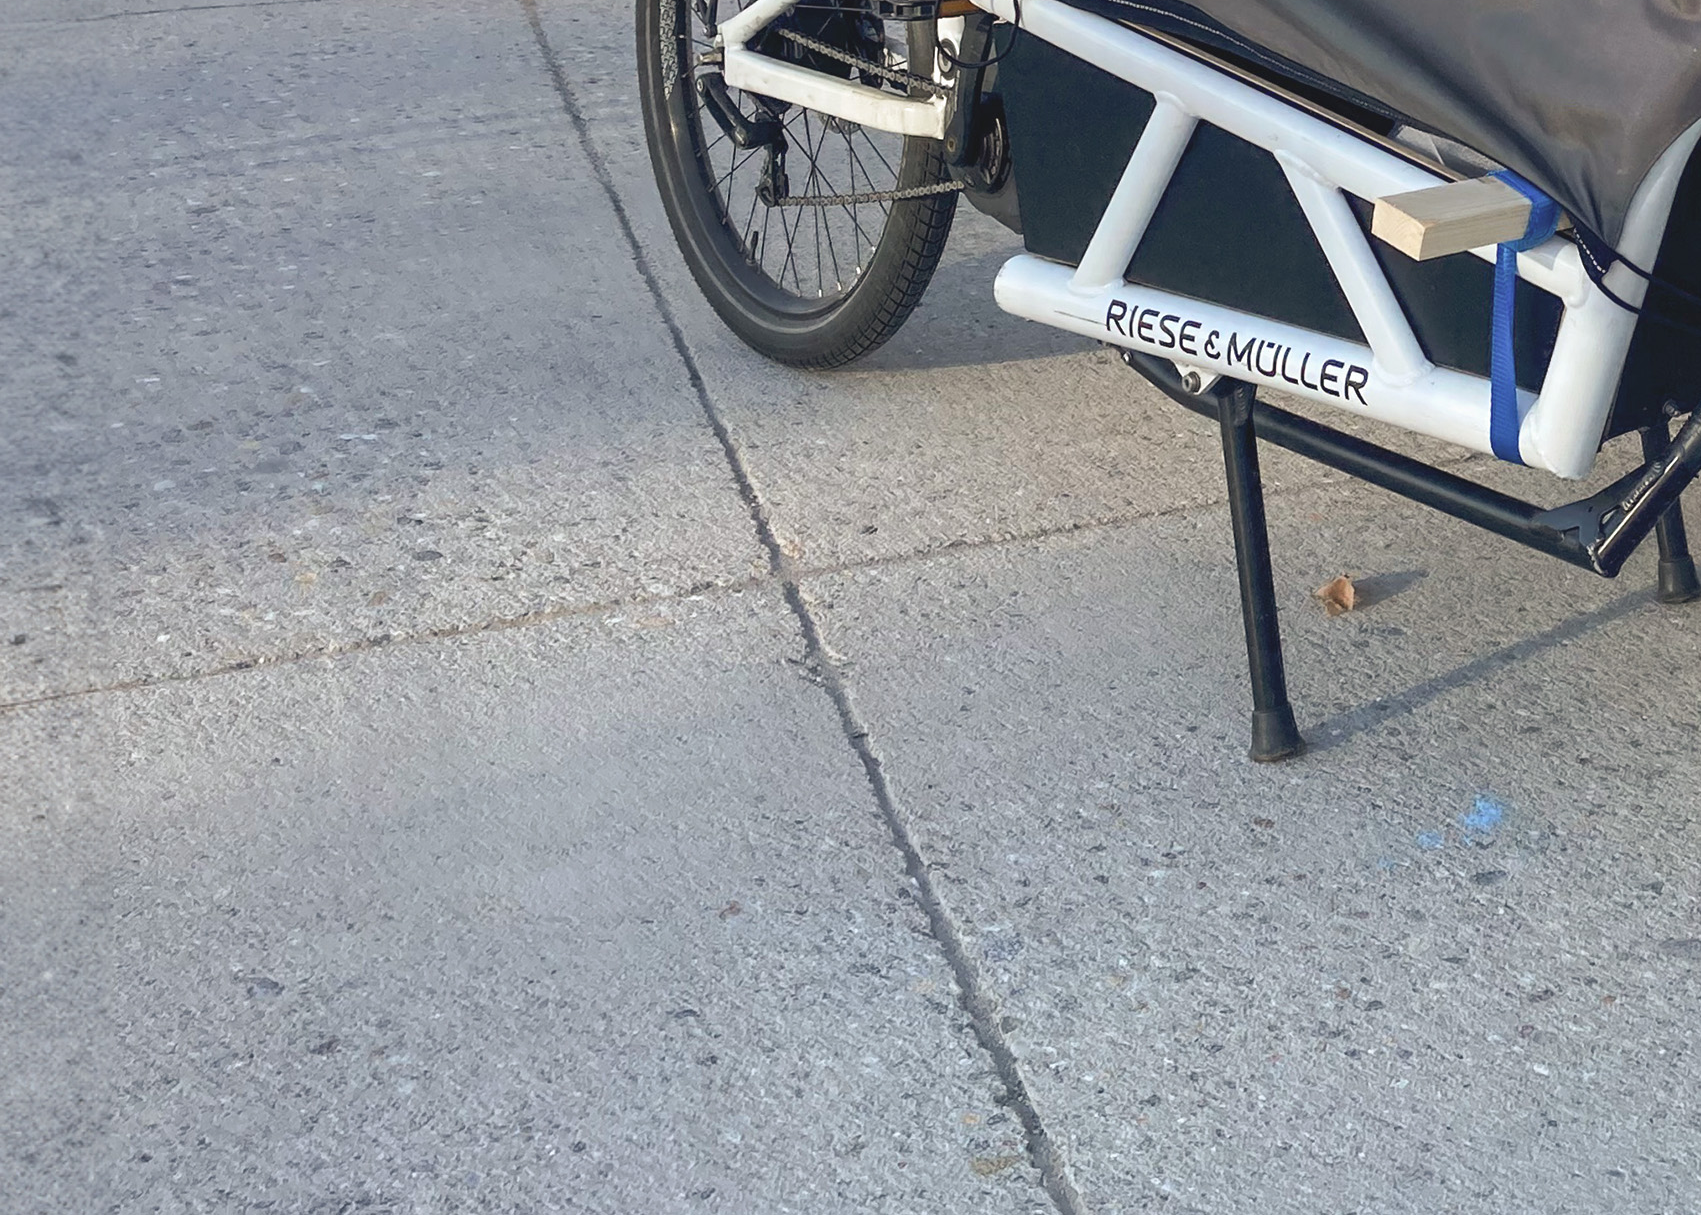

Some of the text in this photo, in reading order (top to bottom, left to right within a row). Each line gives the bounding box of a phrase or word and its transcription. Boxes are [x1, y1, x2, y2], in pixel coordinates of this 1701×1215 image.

[1105, 298, 1370, 406] RIESE & MÜLLER
